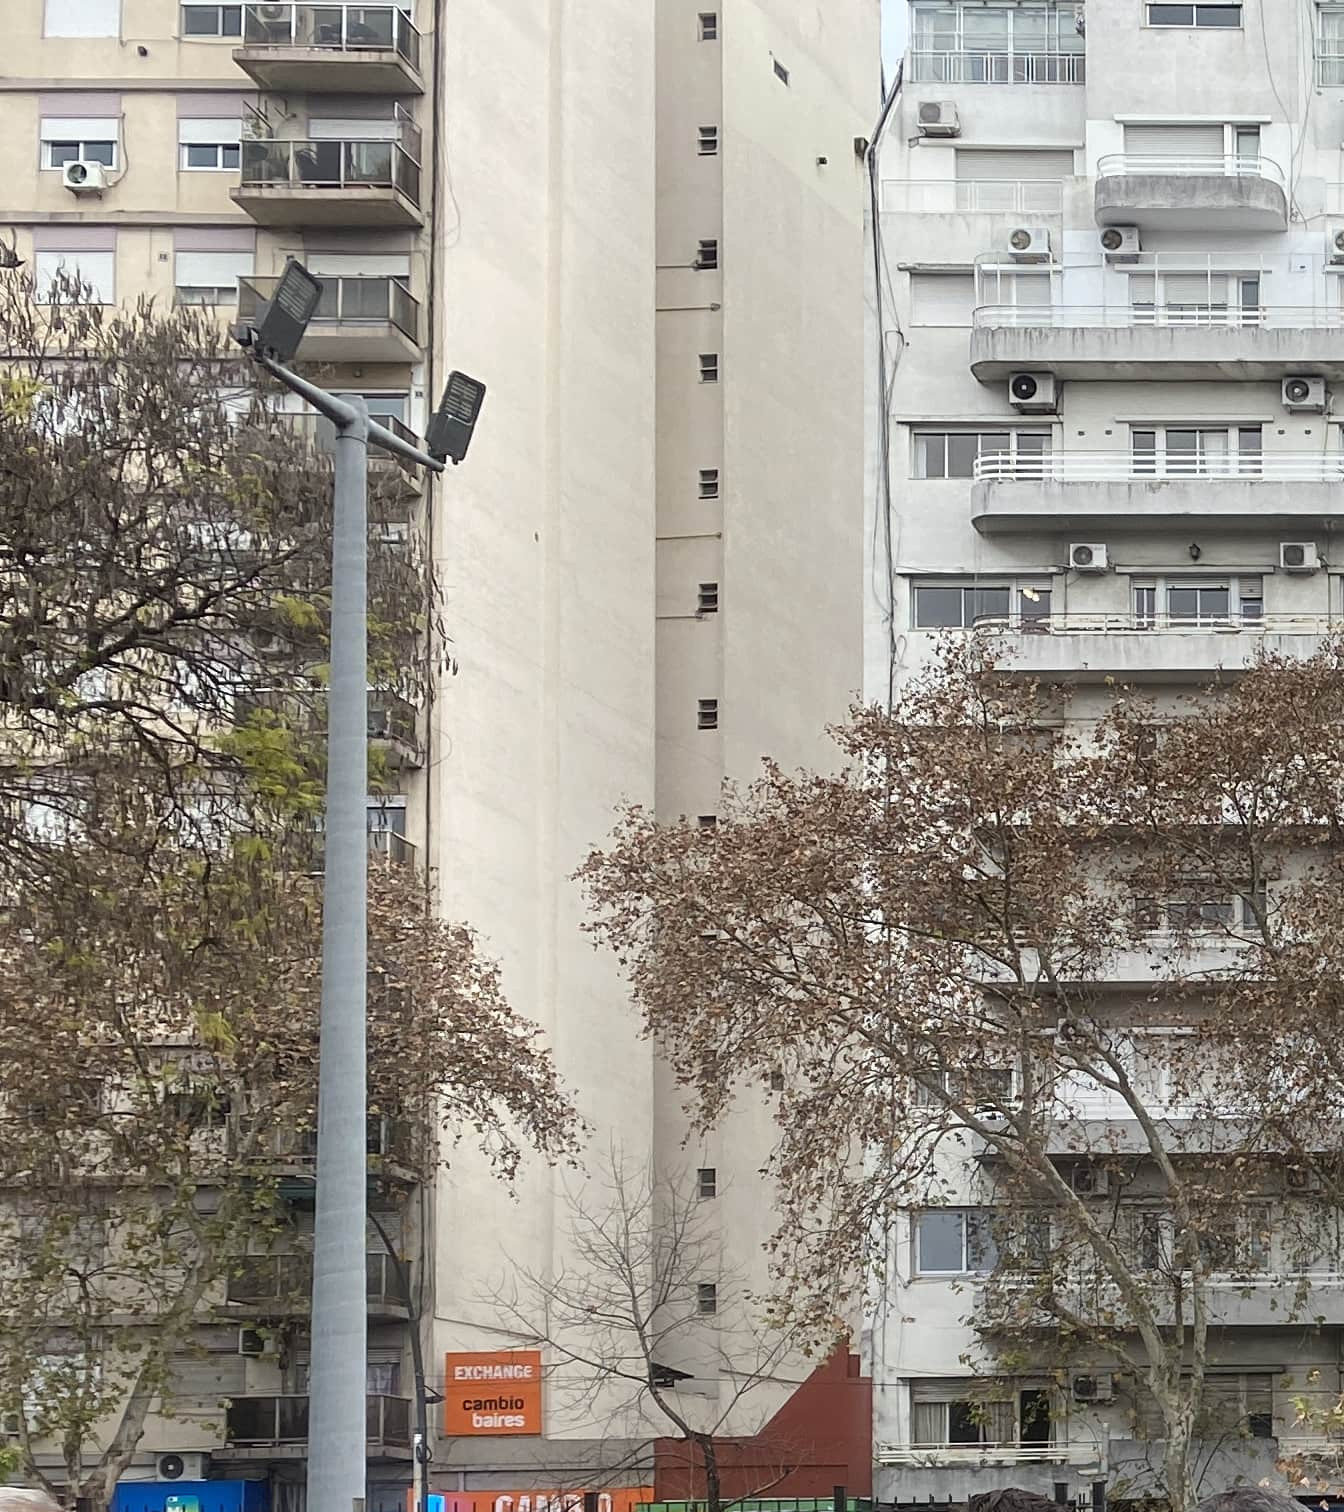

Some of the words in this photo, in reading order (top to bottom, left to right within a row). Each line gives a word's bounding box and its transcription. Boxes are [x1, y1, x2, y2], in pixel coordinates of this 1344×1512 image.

[454, 1364, 533, 1380] EXCHANGE
[463, 1396, 525, 1411] cambio
[472, 1413, 526, 1428] baires
